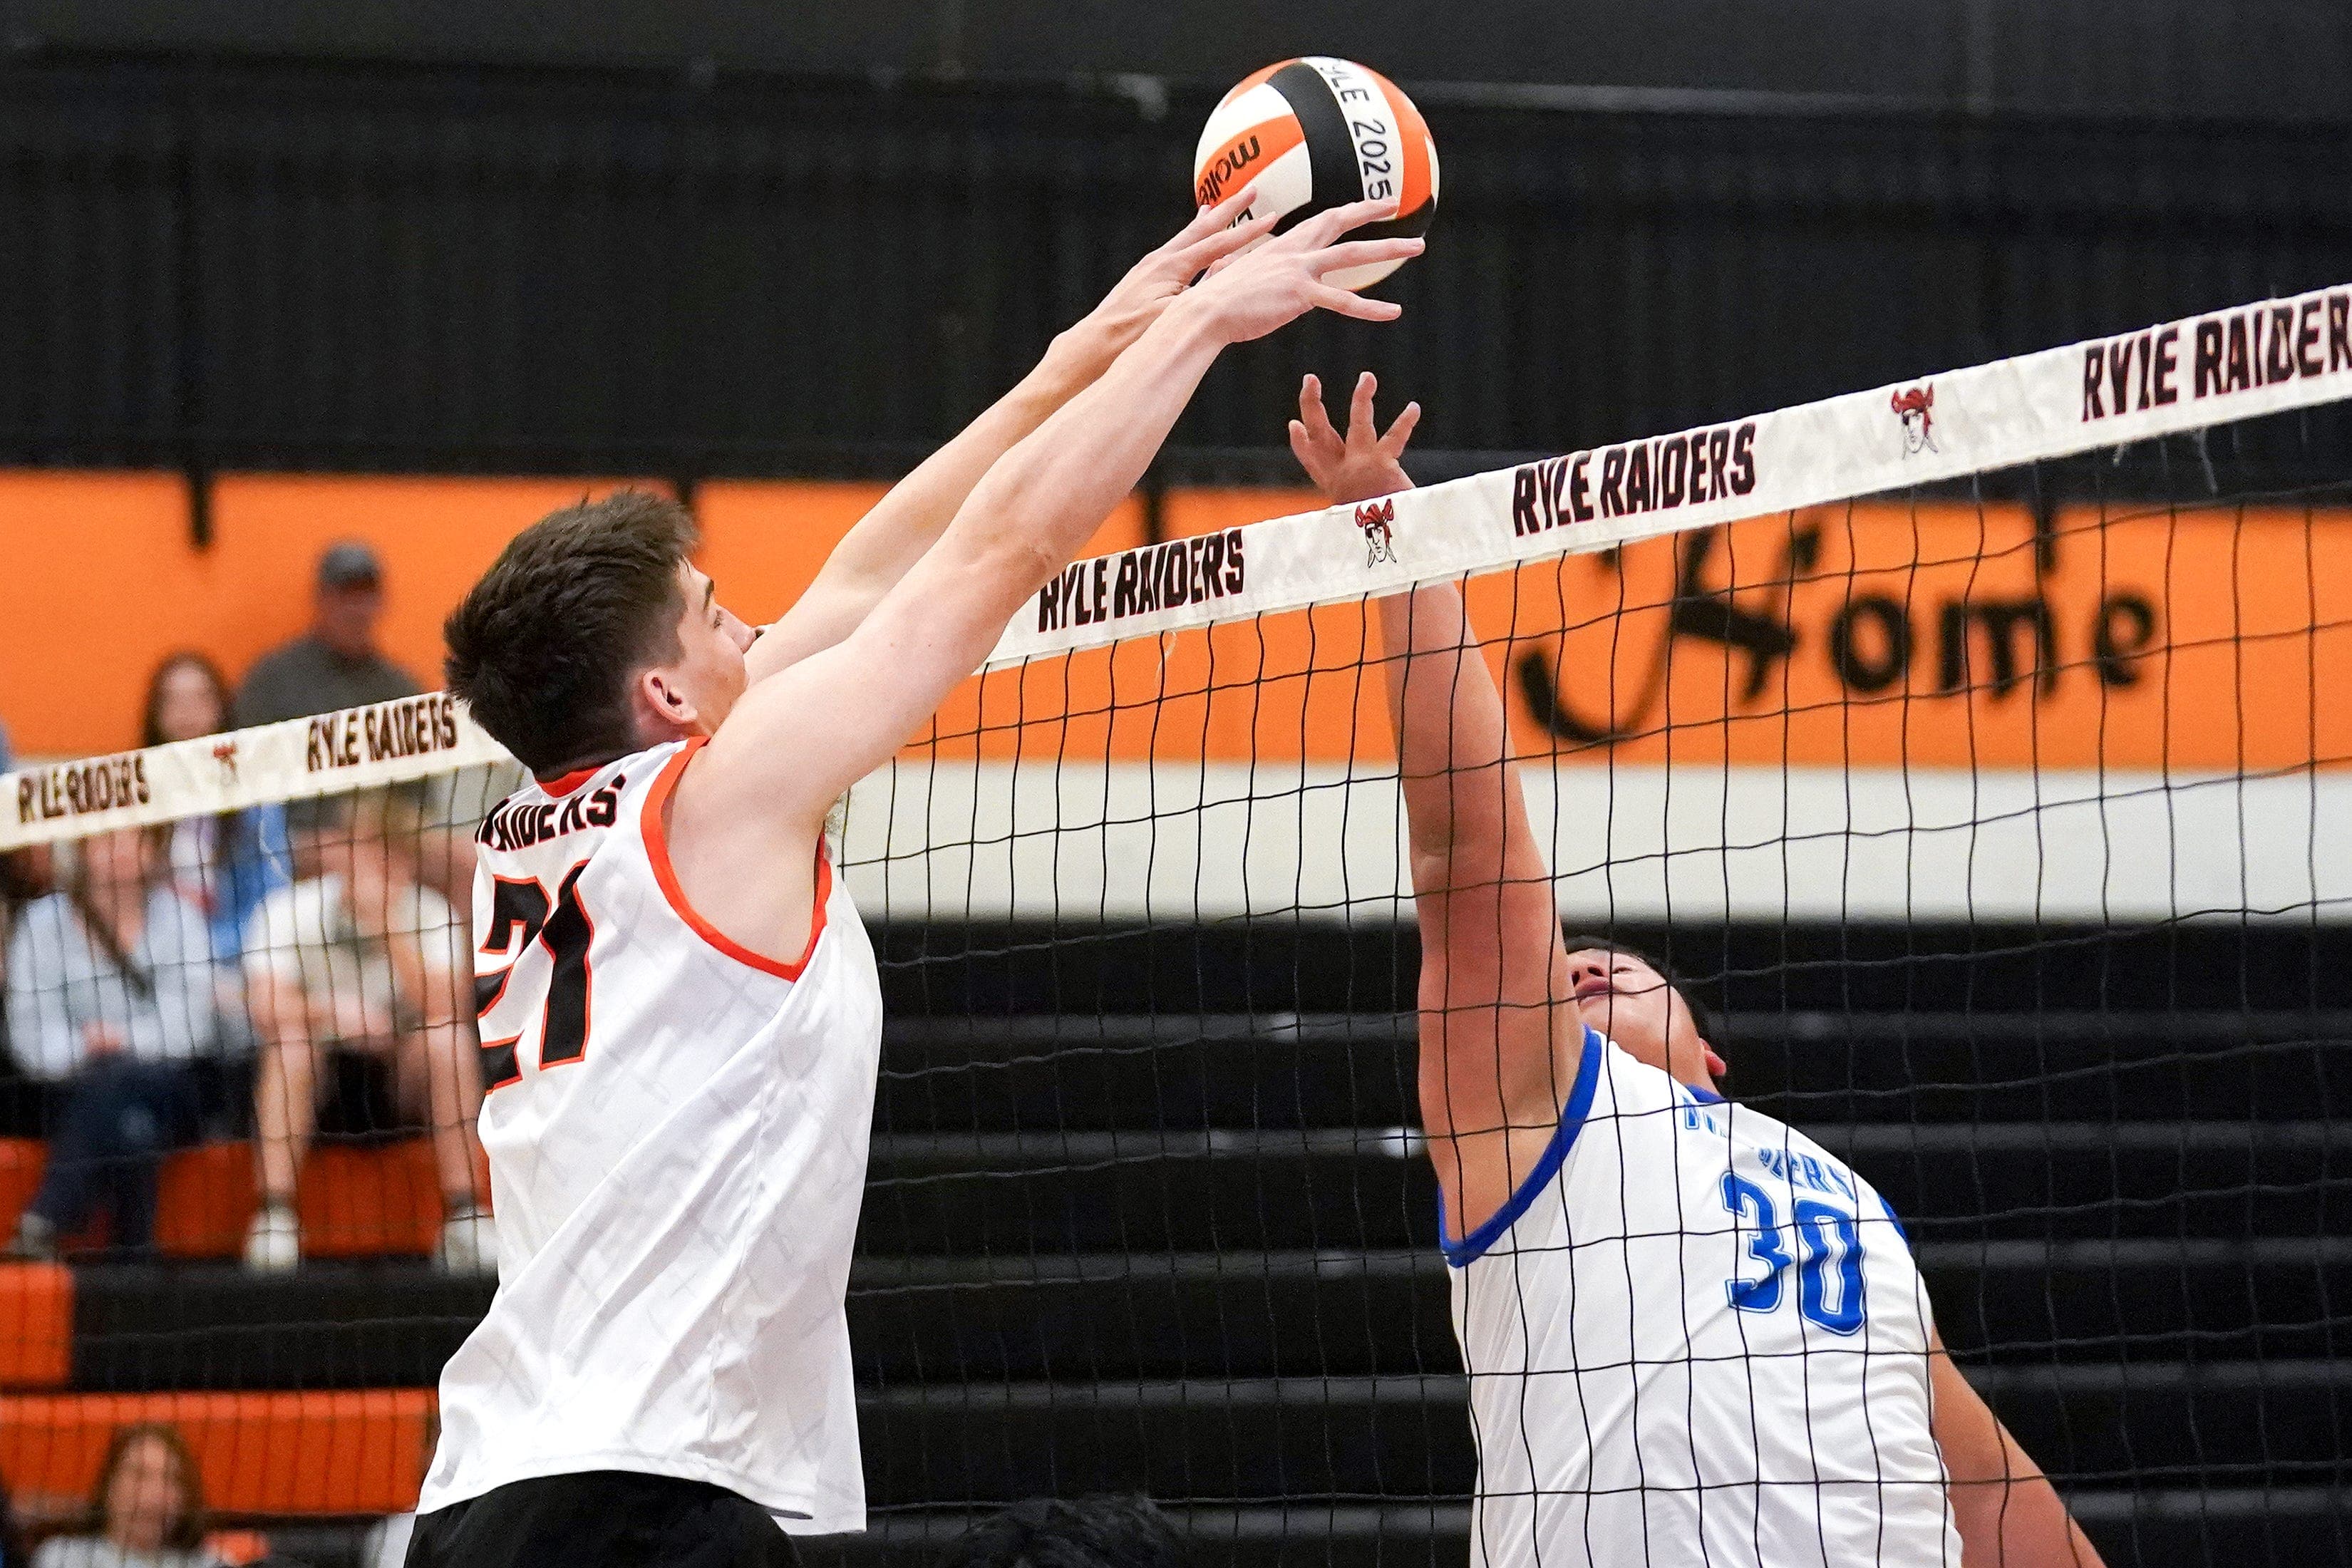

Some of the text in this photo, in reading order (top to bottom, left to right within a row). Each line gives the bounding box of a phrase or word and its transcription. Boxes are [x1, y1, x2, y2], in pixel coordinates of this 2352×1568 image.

[1197, 135, 1261, 205] molte
[1353, 118, 1393, 200] 2025
[1512, 422, 1756, 537] RYLE RAIDERS
[1038, 529, 1244, 633] RYLE RAIDERS
[1514, 522, 2158, 744] Home
[365, 696, 457, 761] RAIDERS
[474, 858, 594, 1095] 21
[1719, 1170, 1867, 1337] 30
